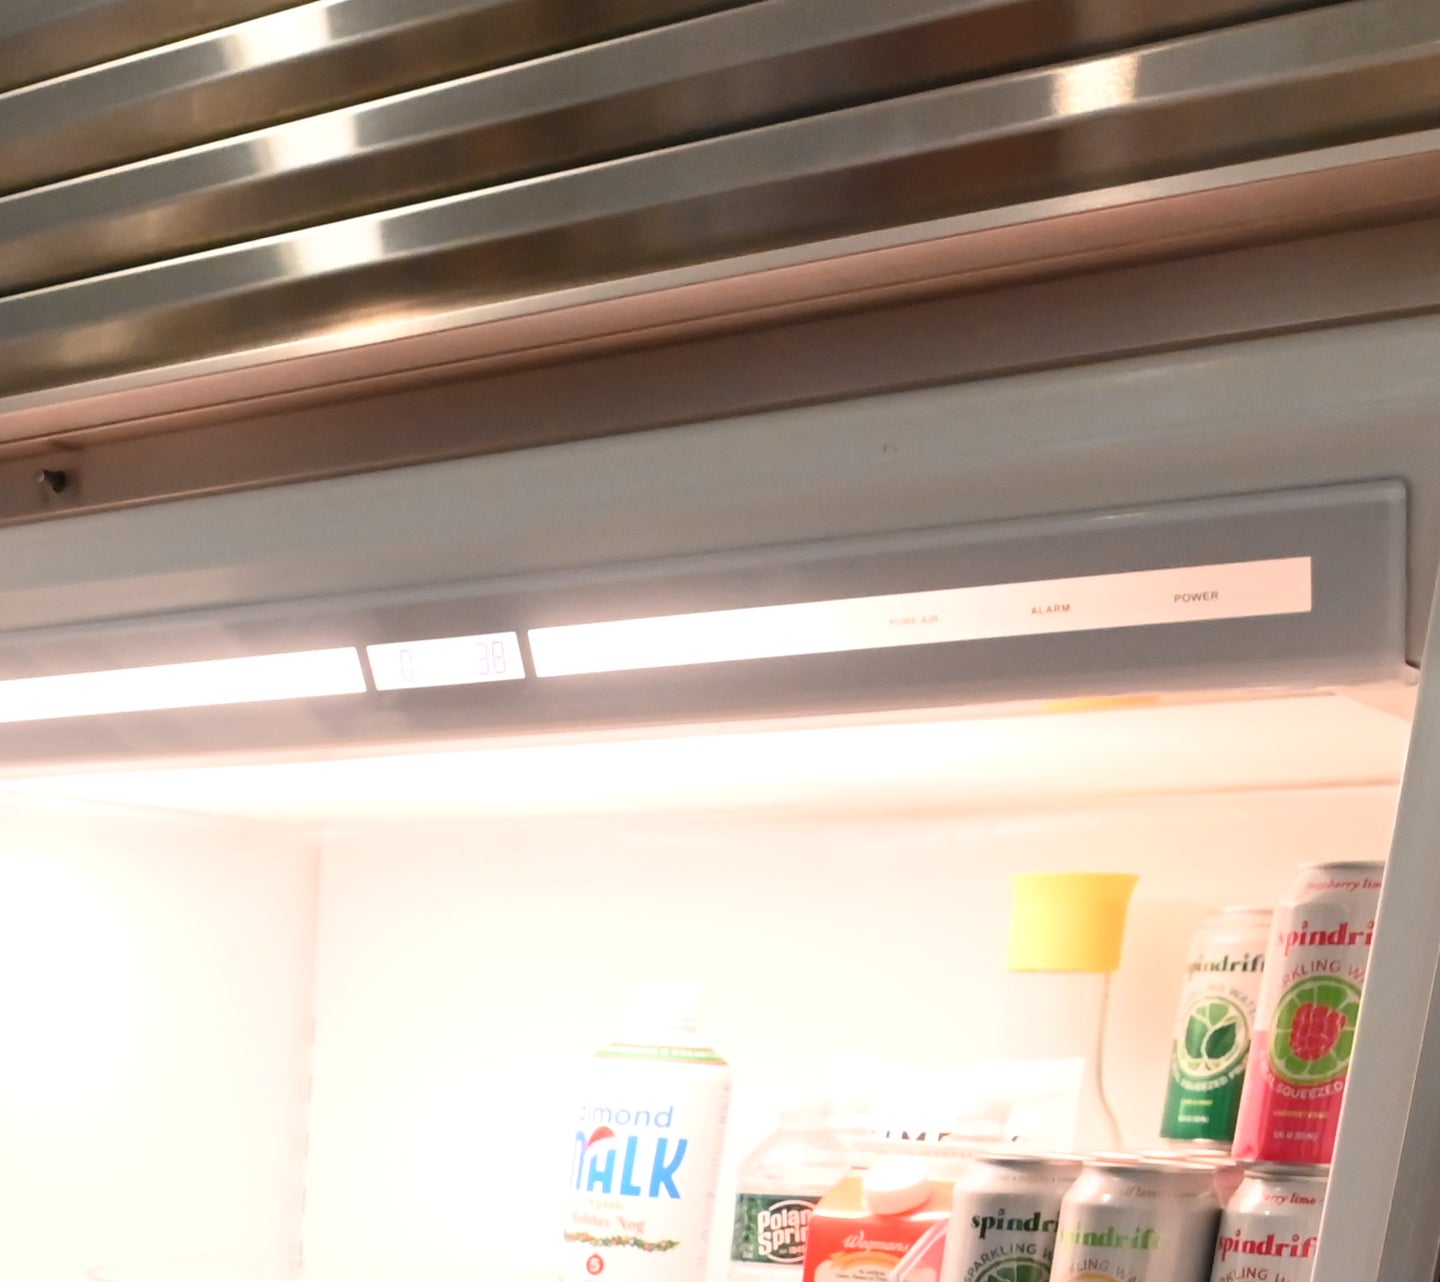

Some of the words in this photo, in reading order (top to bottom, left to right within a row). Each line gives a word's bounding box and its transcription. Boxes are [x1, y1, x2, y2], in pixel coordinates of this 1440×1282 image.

[1174, 590, 1219, 603] POWER
[1031, 603, 1071, 616] ALARM
[758, 1208, 813, 1235] Polan
[758, 1226, 809, 1255] Sprin
[842, 1230, 909, 1252] Wegmans
